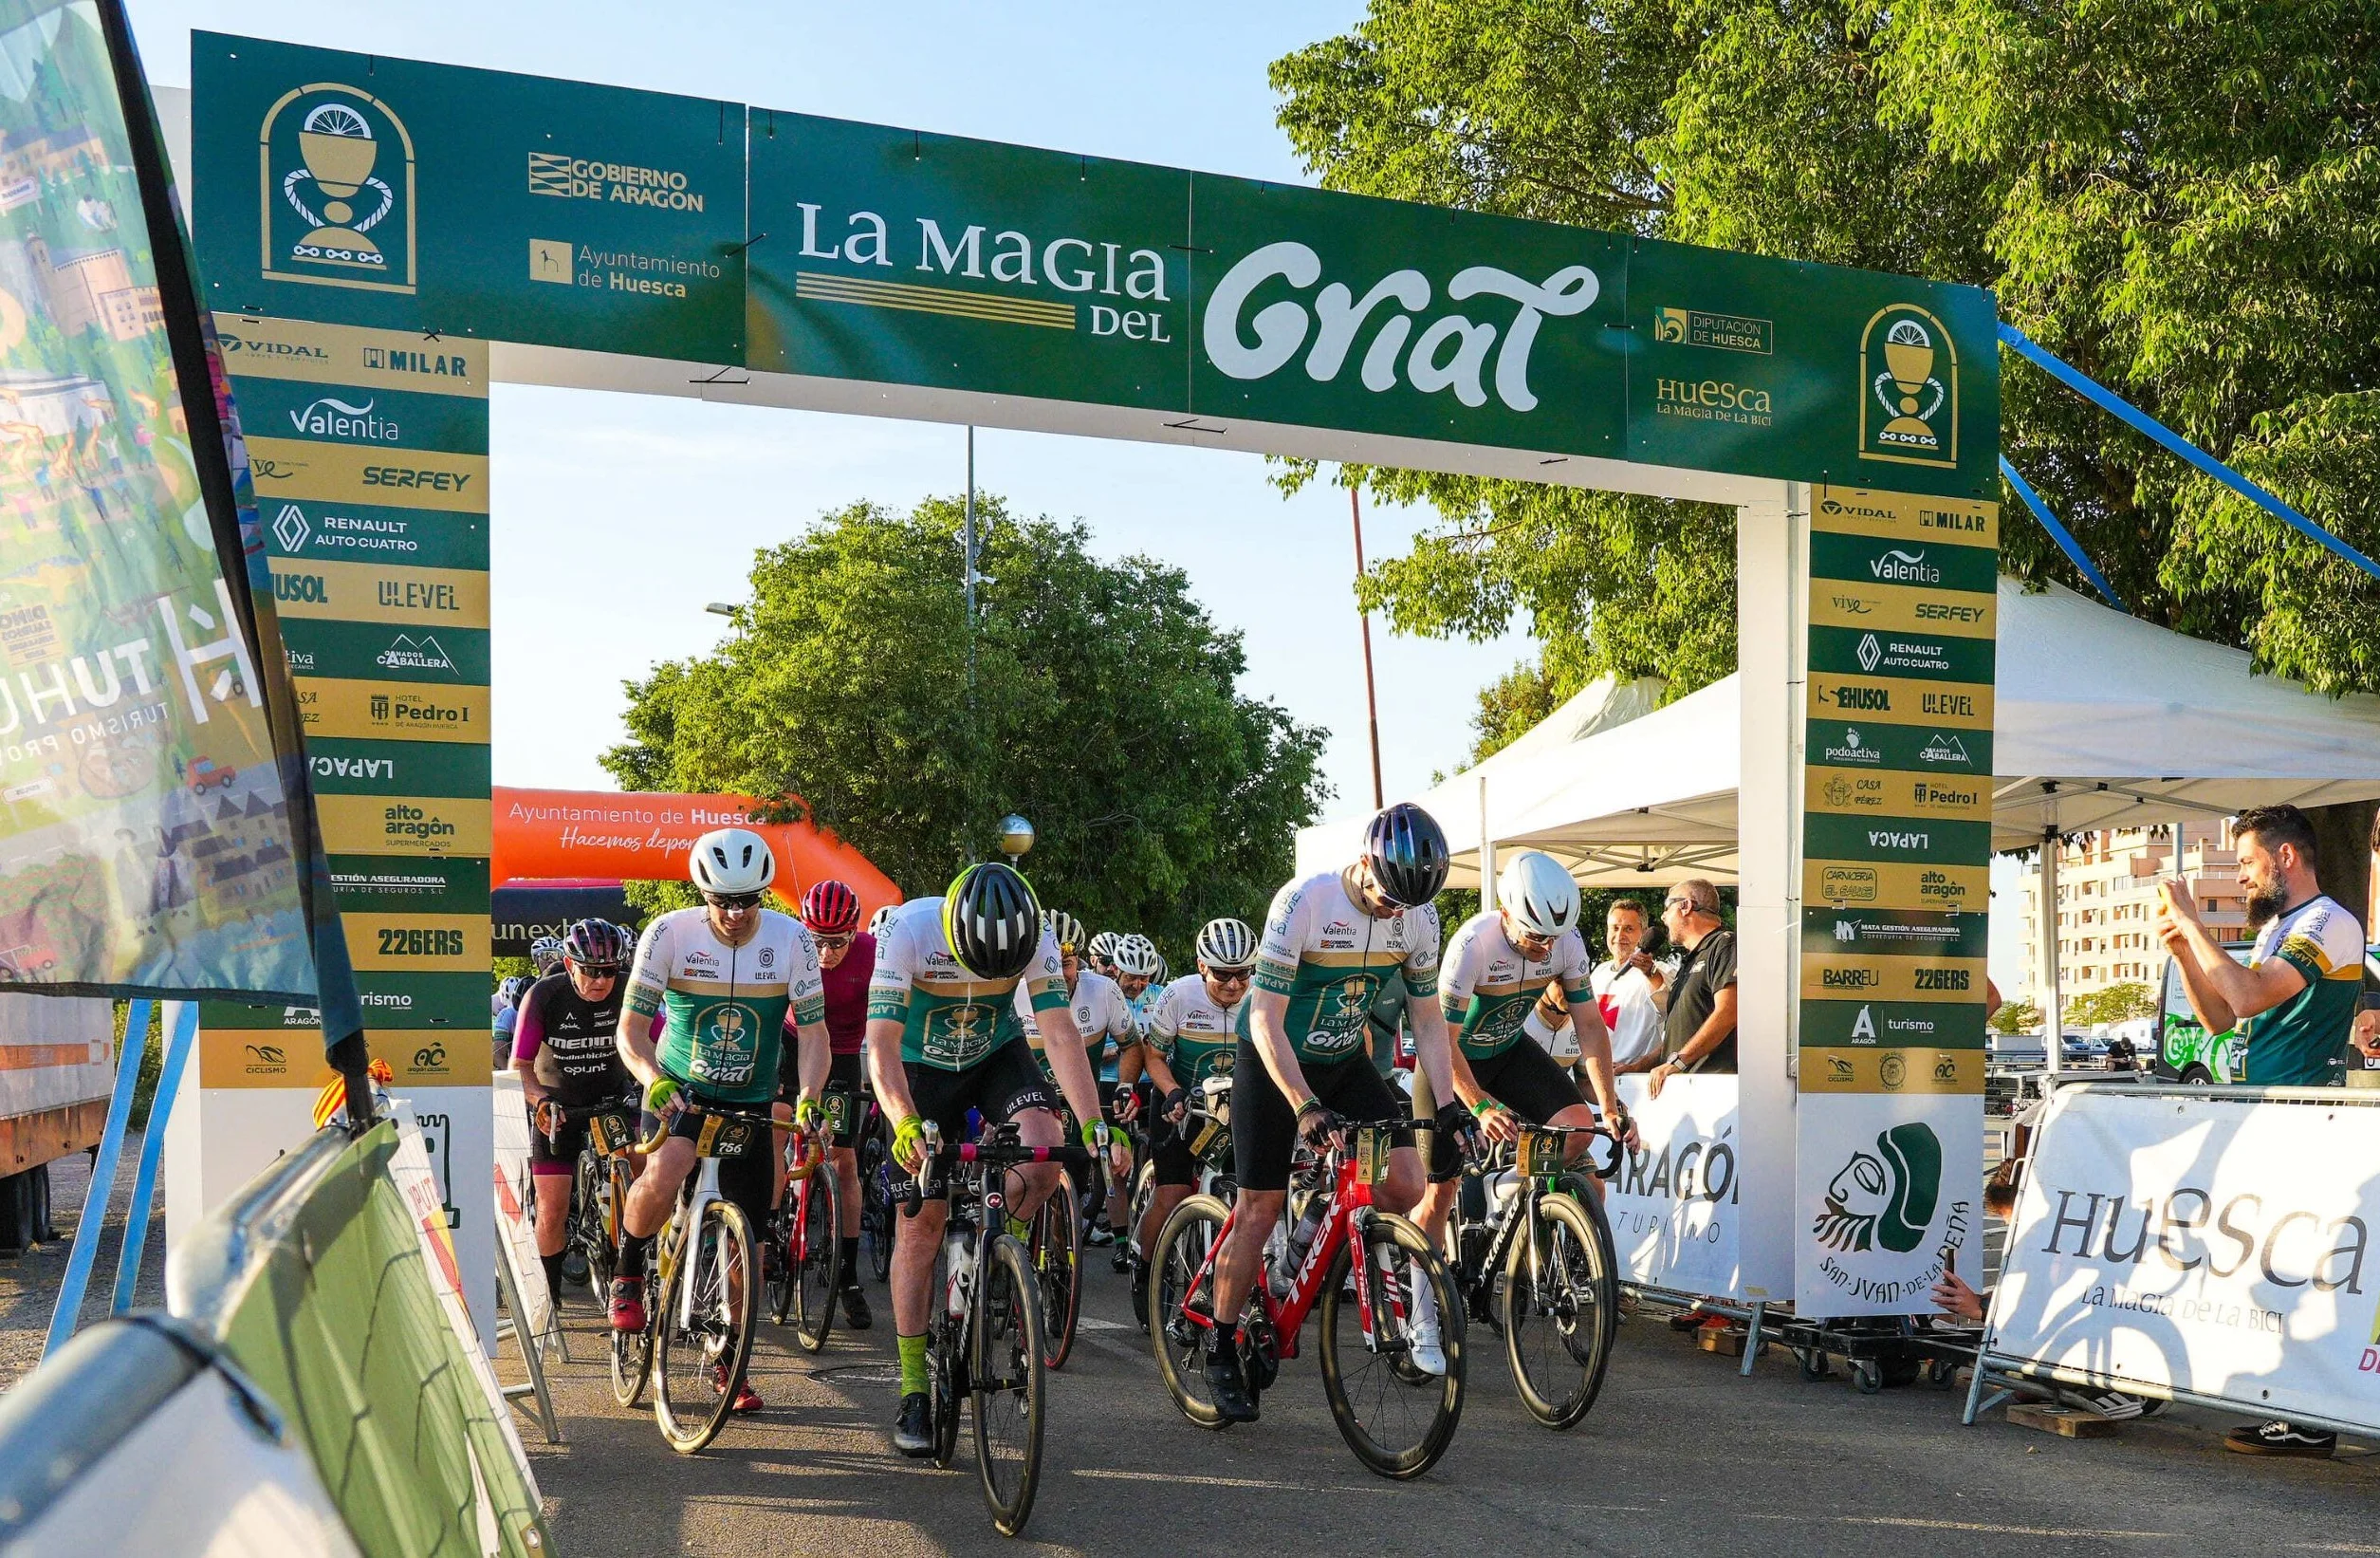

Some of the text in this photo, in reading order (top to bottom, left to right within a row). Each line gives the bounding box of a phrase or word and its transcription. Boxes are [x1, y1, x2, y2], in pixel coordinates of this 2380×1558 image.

[572, 159, 687, 190] GOBIERNO
[572, 180, 704, 213] DE ARAGON
[797, 202, 893, 267] La
[579, 245, 721, 279] Ayuntamiento
[579, 269, 686, 298] de Huesca
[1693, 316, 1762, 334] DIPUTACIÓN
[1693, 330, 1761, 349] DE HUESCA
[245, 342, 328, 358] VIDAL
[390, 350, 466, 377] MILAR
[1656, 378, 1771, 413] Huesca
[289, 398, 398, 440] Valentia
[1751, 416, 1772, 427] BICI
[362, 466, 471, 492] SERFEY
[1844, 507, 1896, 519] VIDAL
[1936, 512, 1985, 531] MILAR
[324, 517, 407, 533] RENAULT
[315, 535, 417, 551] AUTO CUATRO
[1871, 549, 1940, 583] Valentia
[271, 573, 327, 603] USOL
[1915, 603, 1985, 622] SERFEY
[1890, 643, 1943, 655] RENAULT
[377, 651, 449, 668] CABALLERA
[1883, 658, 1949, 670] AUTO CUATRO
[396, 705, 457, 722] Pedro
[1826, 746, 1880, 760] podoactiva
[1920, 748, 1966, 762] CABALLERA
[1856, 780, 1881, 790] CASA
[1930, 790, 1970, 804] Pedro
[385, 805, 422, 820] alto
[509, 803, 654, 825] Ayuntamiento
[660, 811, 684, 824] de
[560, 826, 704, 859] Hacemos depor
[1869, 831, 1928, 849] LAPACA
[331, 874, 446, 884] ESTIÓN ASEGURADORA
[1921, 871, 1946, 883] alto
[1323, 923, 1356, 936] Valentia
[378, 929, 463, 955] 226ERS
[686, 954, 720, 966] Valentia
[1823, 969, 1879, 986] BARREU
[1915, 969, 1969, 990] 226ERS
[1888, 1018, 1934, 1030] turismo
[719, 1141, 743, 1153] 756
[1605, 1125, 1738, 1204] ARAGÓ
[2041, 1187, 2368, 1295] Huesca
[1288, 1196, 1341, 1305] TREK
[2249, 1308, 2283, 1334] BICI
